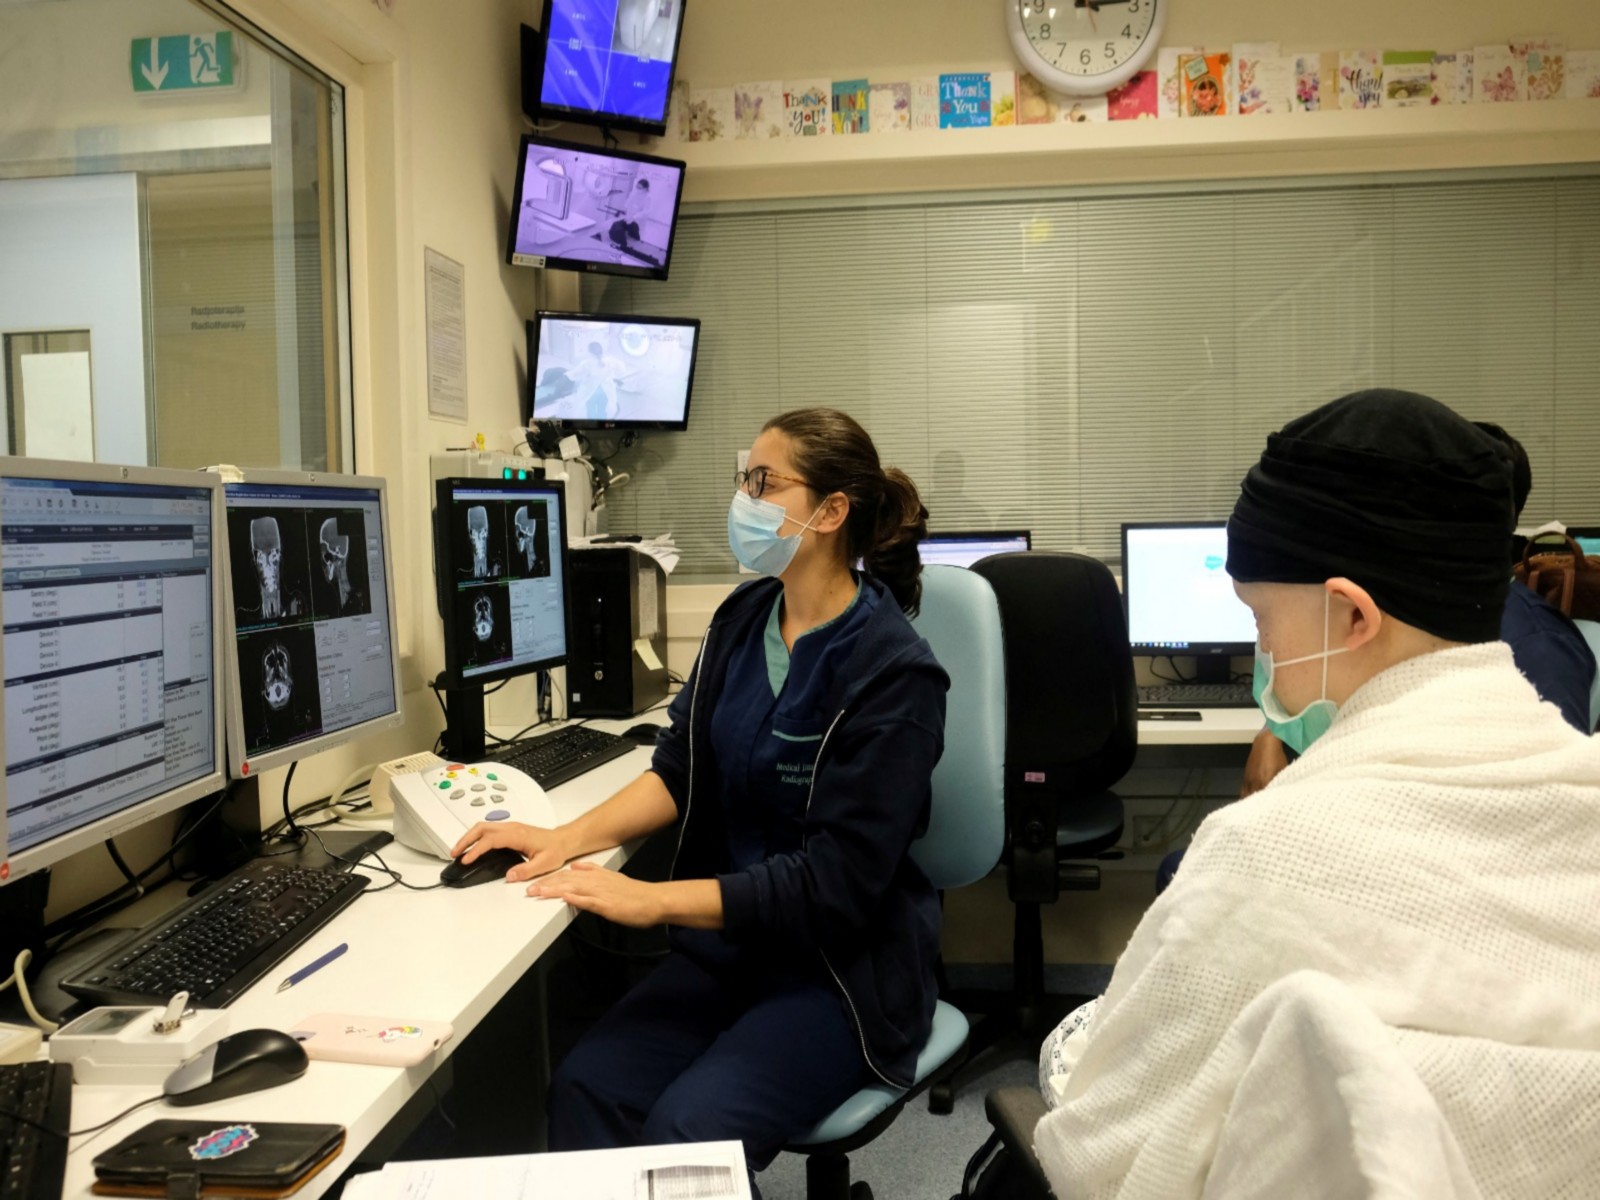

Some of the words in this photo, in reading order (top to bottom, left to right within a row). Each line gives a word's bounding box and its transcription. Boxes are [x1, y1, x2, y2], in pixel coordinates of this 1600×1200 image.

[1034, 0, 1045, 14] 9
[1128, 0, 1139, 13] 3
[1040, 23, 1051, 40] 8
[1121, 24, 1132, 39] 4
[1056, 42, 1067, 58] 7
[1080, 49, 1091, 65] 6
[1104, 42, 1115, 58] 5
[941, 81, 988, 100] Thank
[952, 98, 978, 115] You
[191, 320, 246, 331] Radiotherapy
[776, 762, 800, 772] Medical
